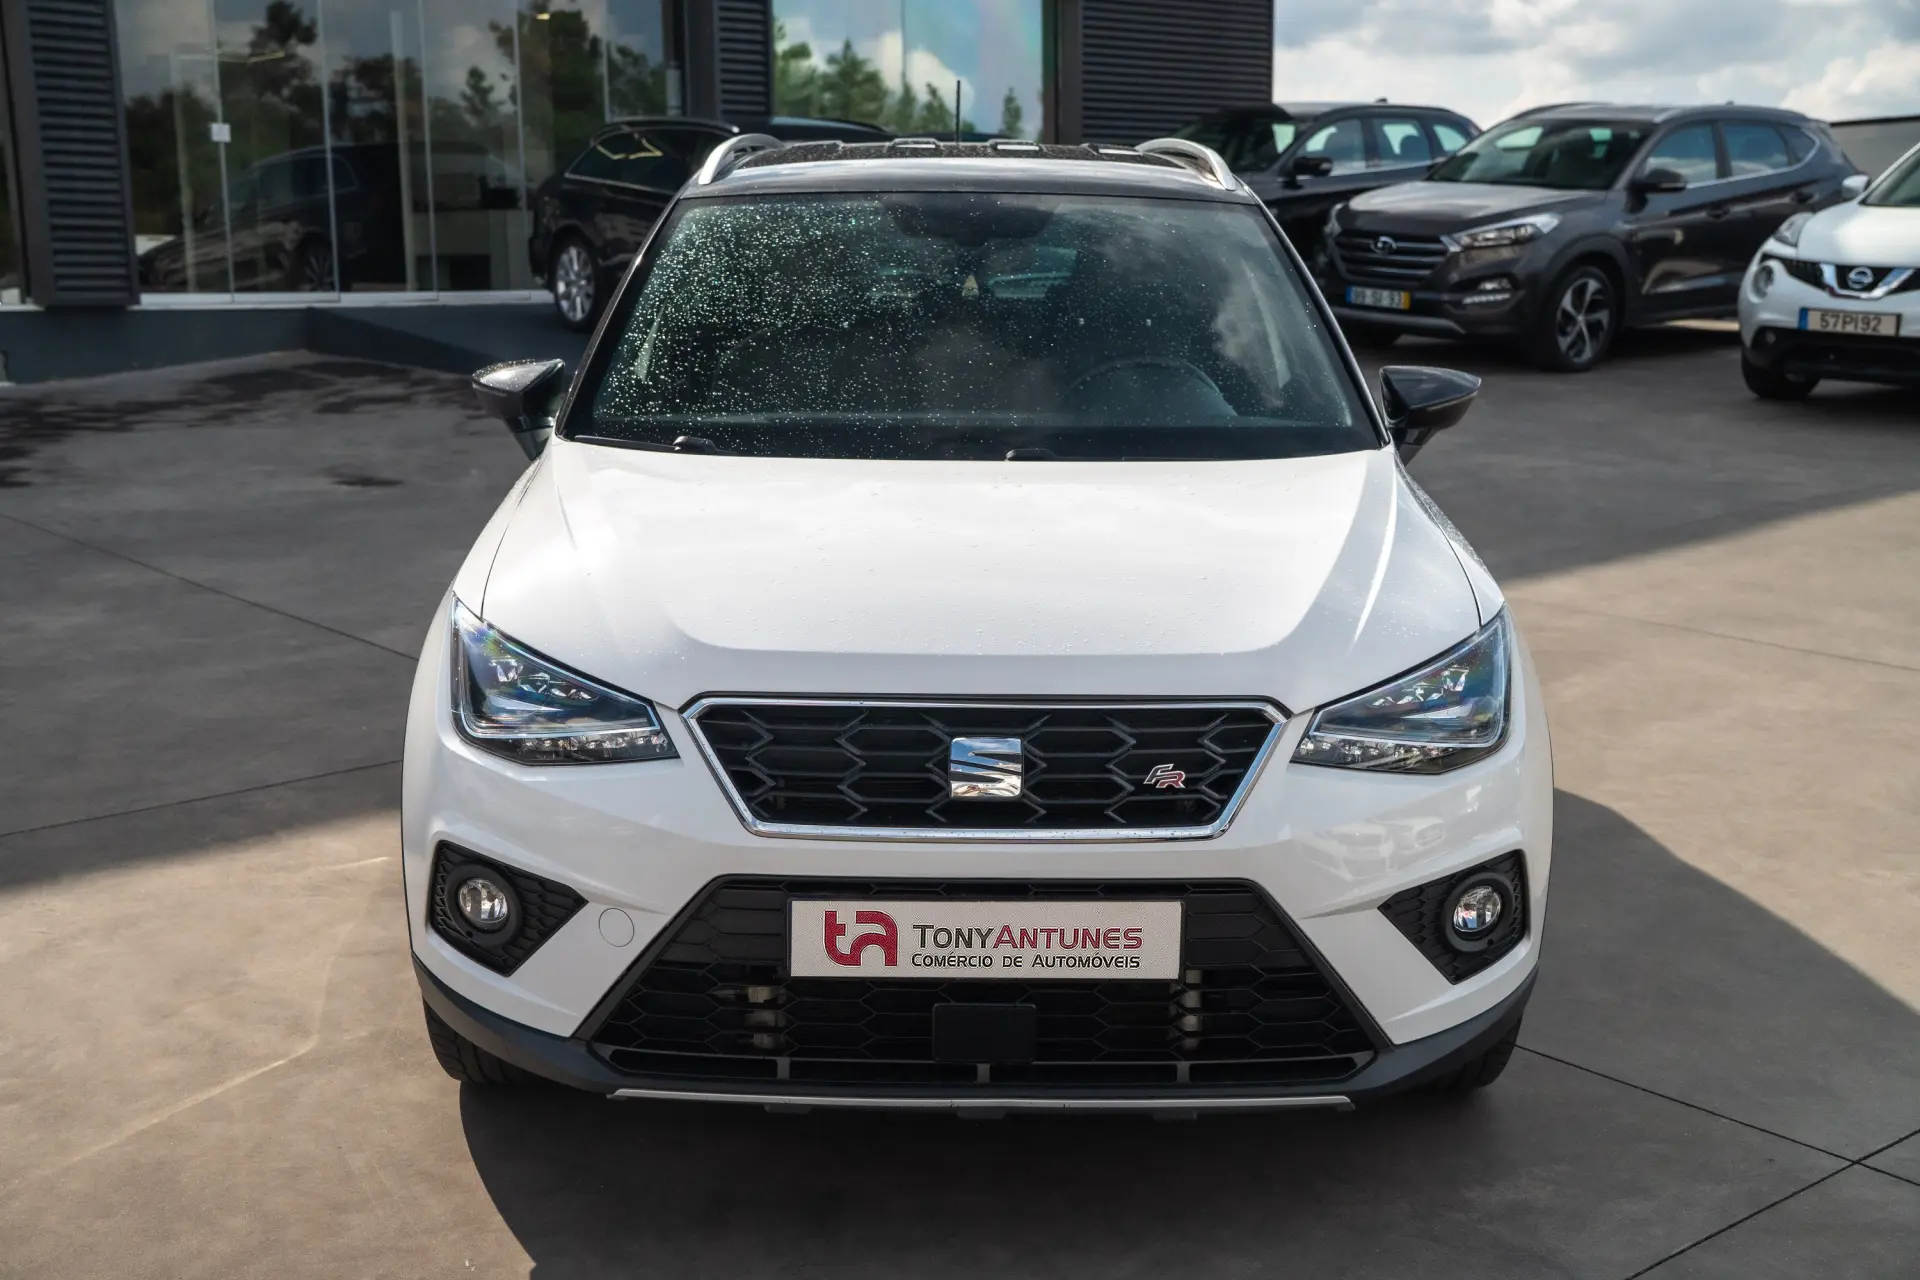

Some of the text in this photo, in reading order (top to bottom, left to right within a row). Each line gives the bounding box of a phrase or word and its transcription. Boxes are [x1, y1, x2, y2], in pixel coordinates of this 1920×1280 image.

[1143, 763, 1186, 788] FR
[911, 951, 1141, 968] COMÉRCIO DE AUTOMÓVEIS
